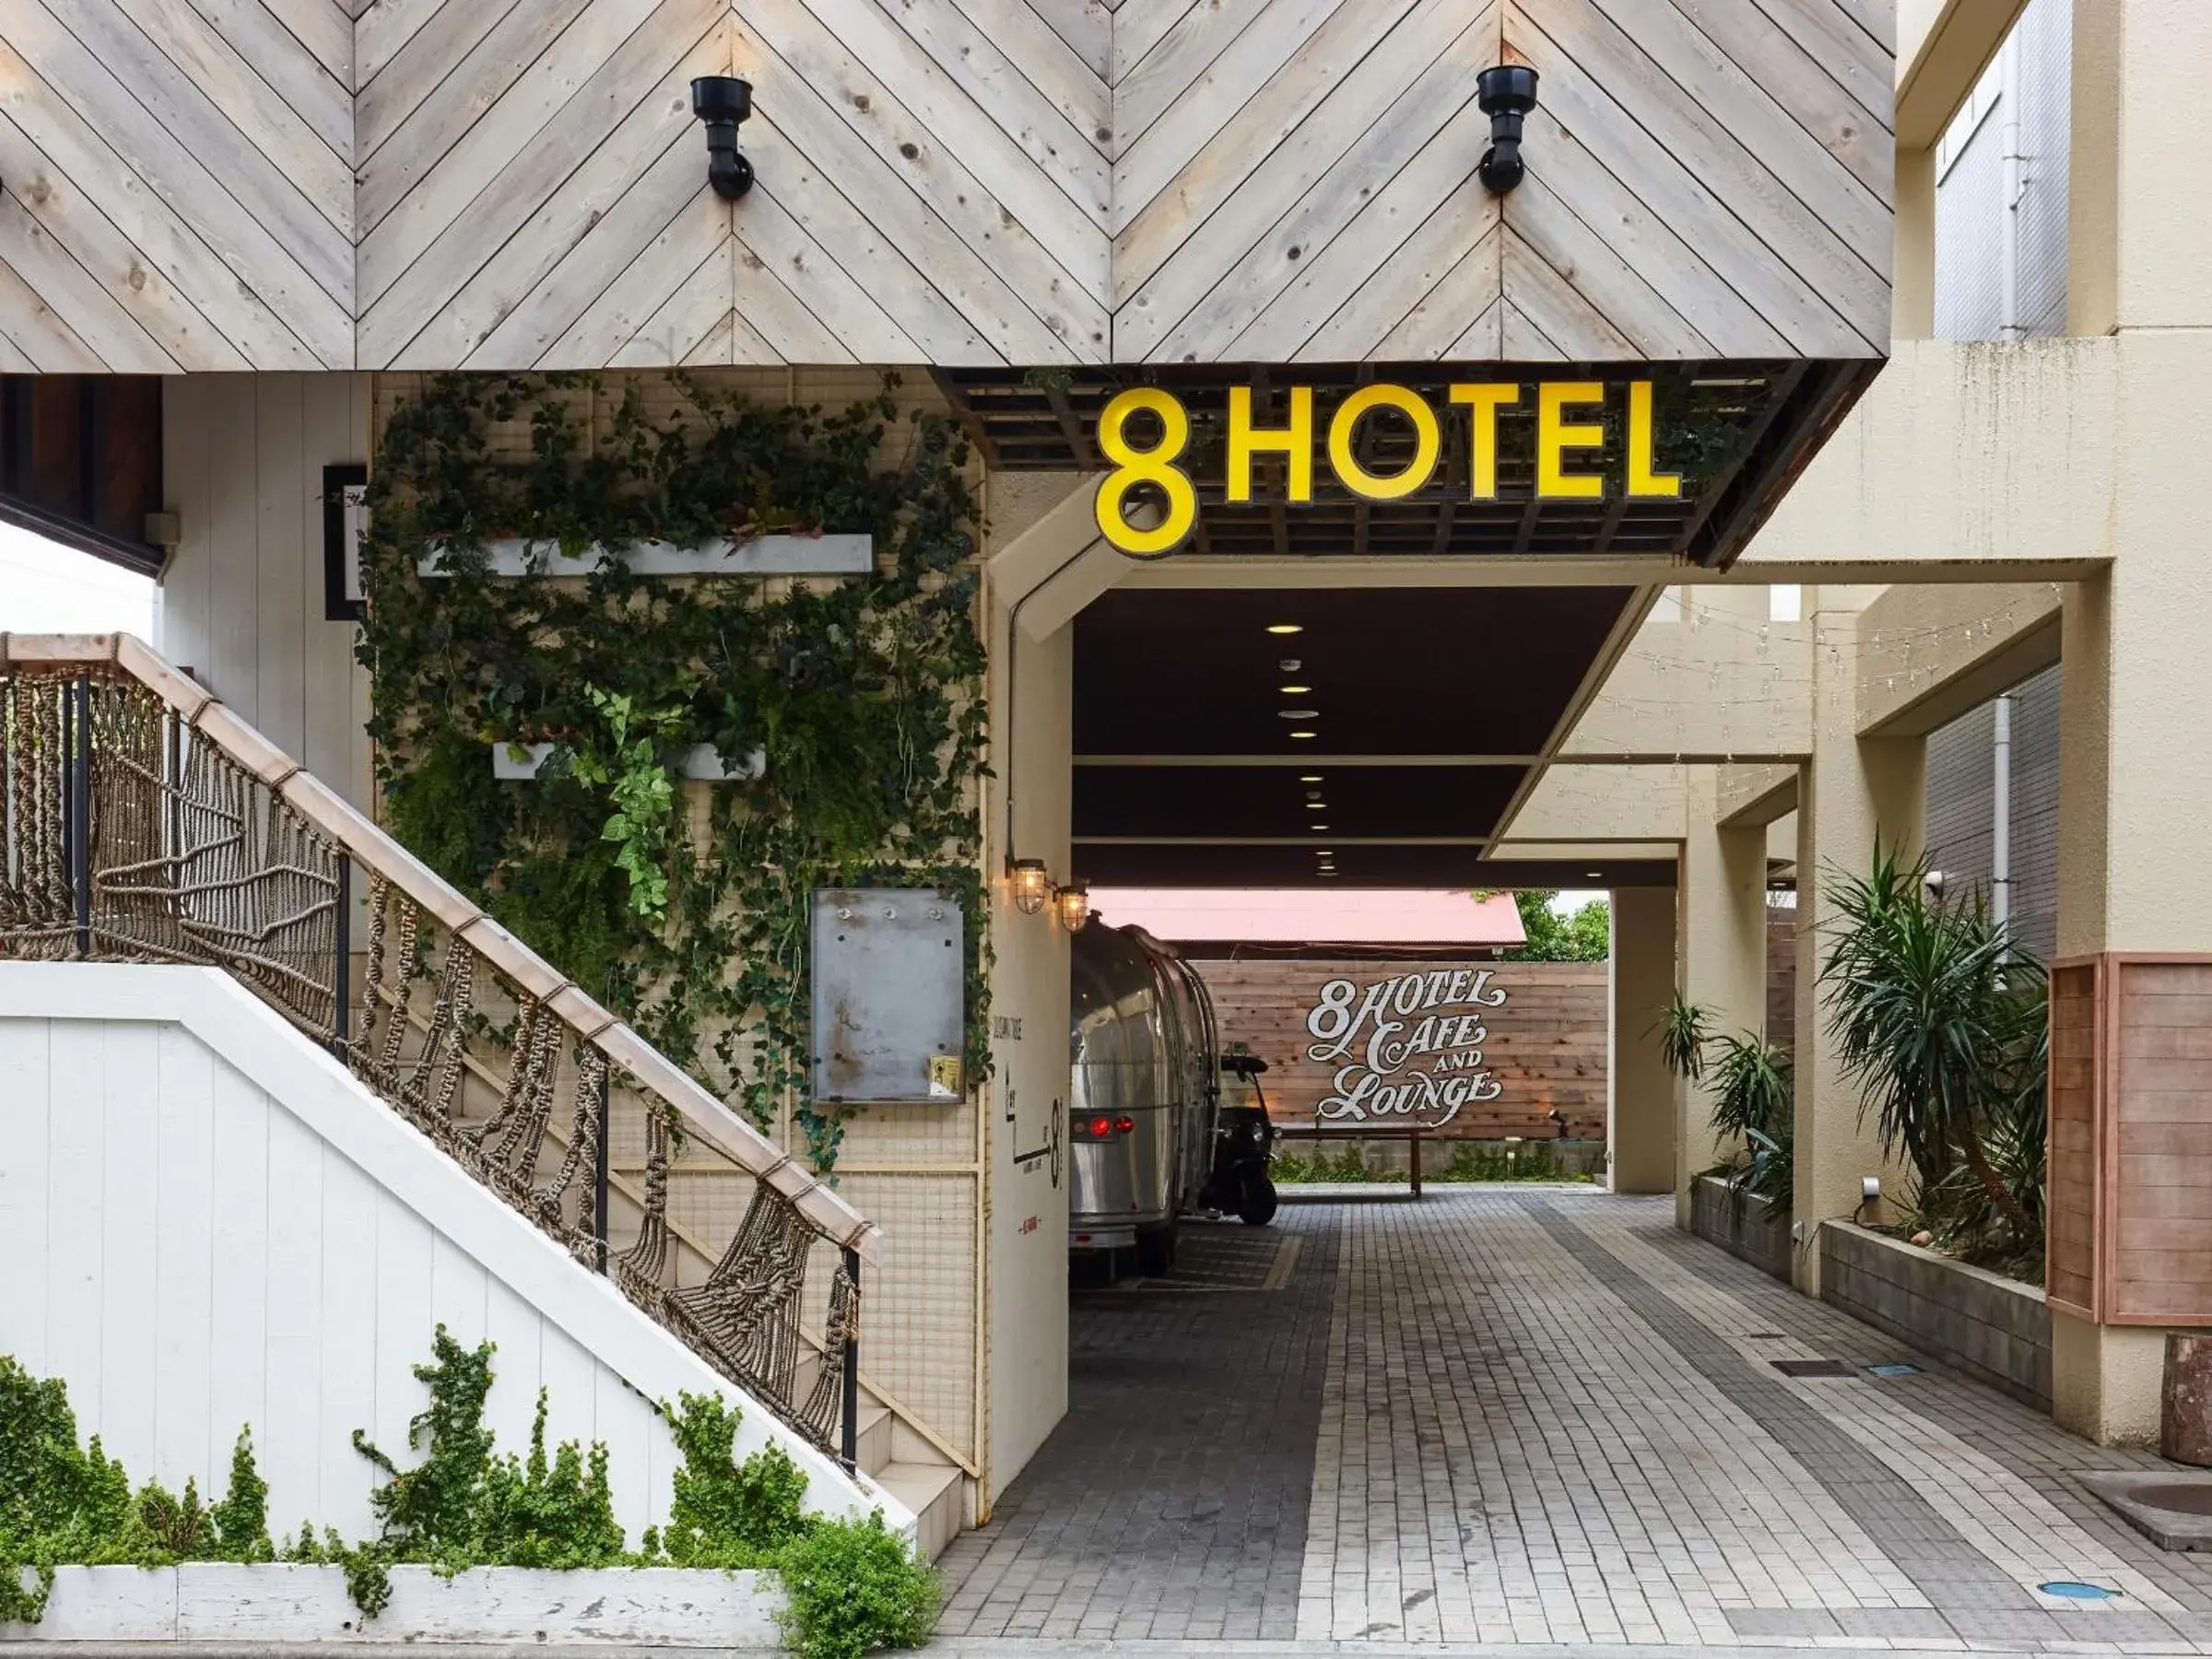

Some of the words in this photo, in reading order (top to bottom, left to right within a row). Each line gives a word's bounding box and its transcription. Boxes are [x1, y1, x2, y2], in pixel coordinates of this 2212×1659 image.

[1095, 385, 1199, 556] 8
[1224, 379, 1683, 504] HOTEL
[1307, 979, 1357, 1039] 8
[1308, 969, 1508, 1062] HOTEL
[1366, 1014, 1488, 1075] CAFE
[1432, 1049, 1483, 1074] AND
[1317, 1065, 1503, 1127] LOUNGE
